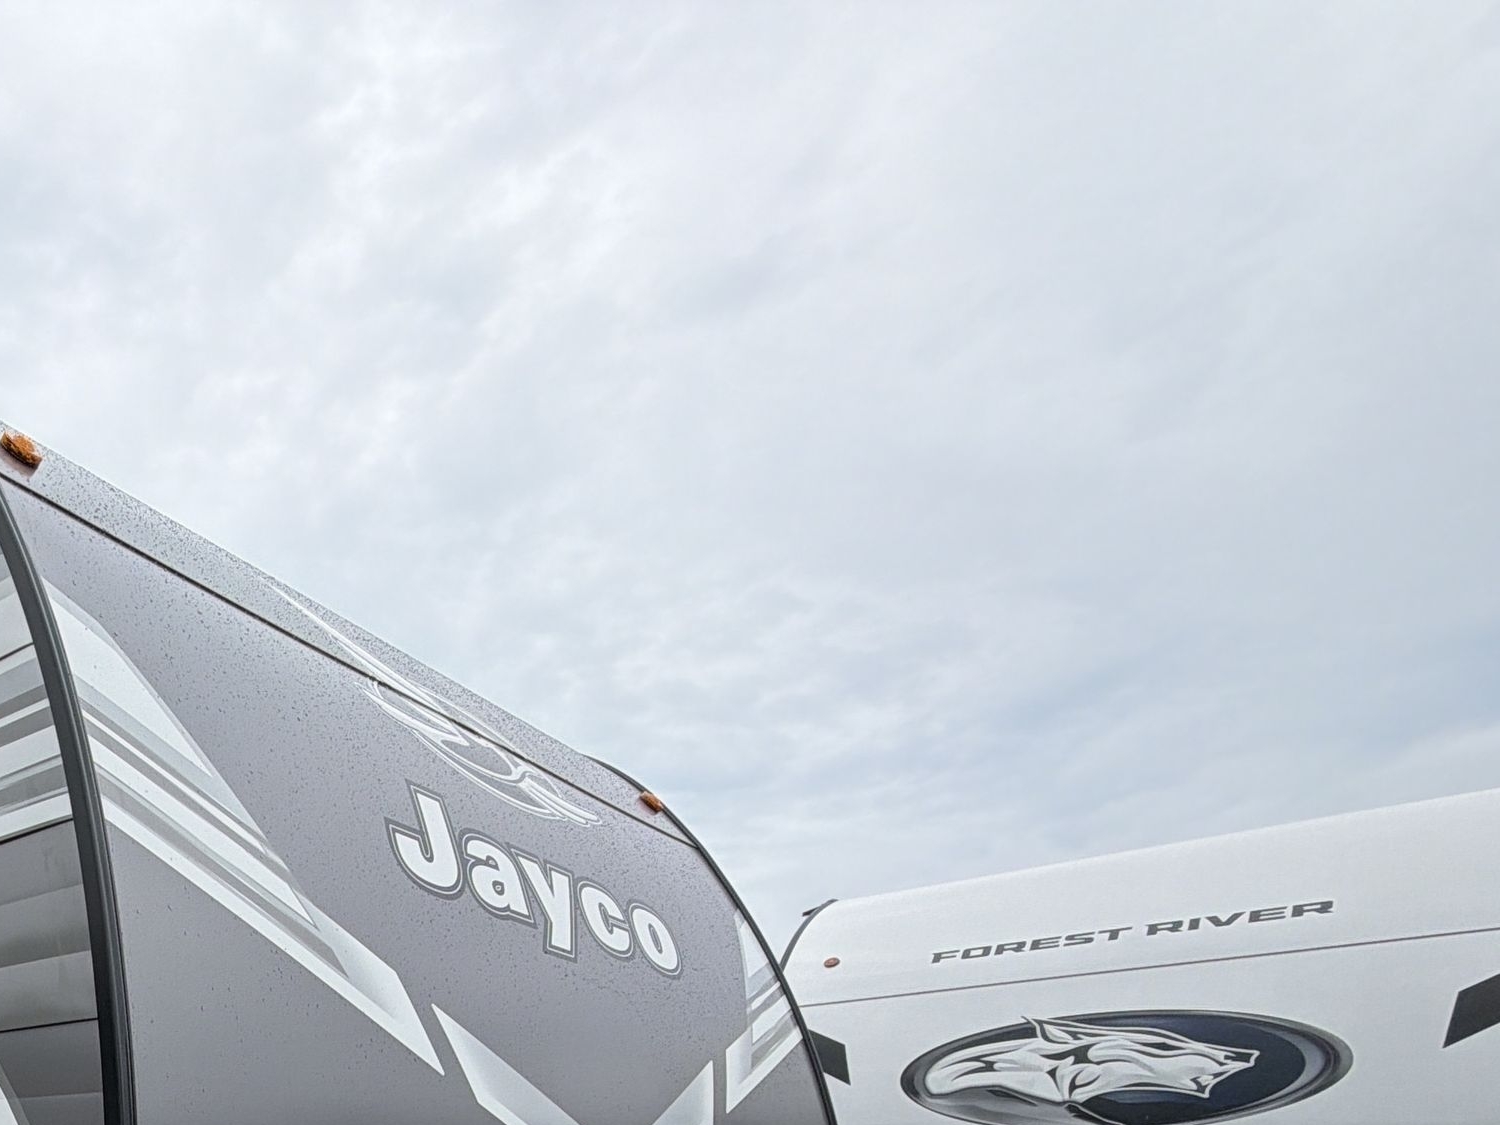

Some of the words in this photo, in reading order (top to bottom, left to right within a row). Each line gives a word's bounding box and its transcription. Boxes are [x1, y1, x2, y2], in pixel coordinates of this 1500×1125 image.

[388, 784, 682, 976] Jayco
[930, 926, 1134, 964] FOREST
[1145, 899, 1335, 937] RIVER
